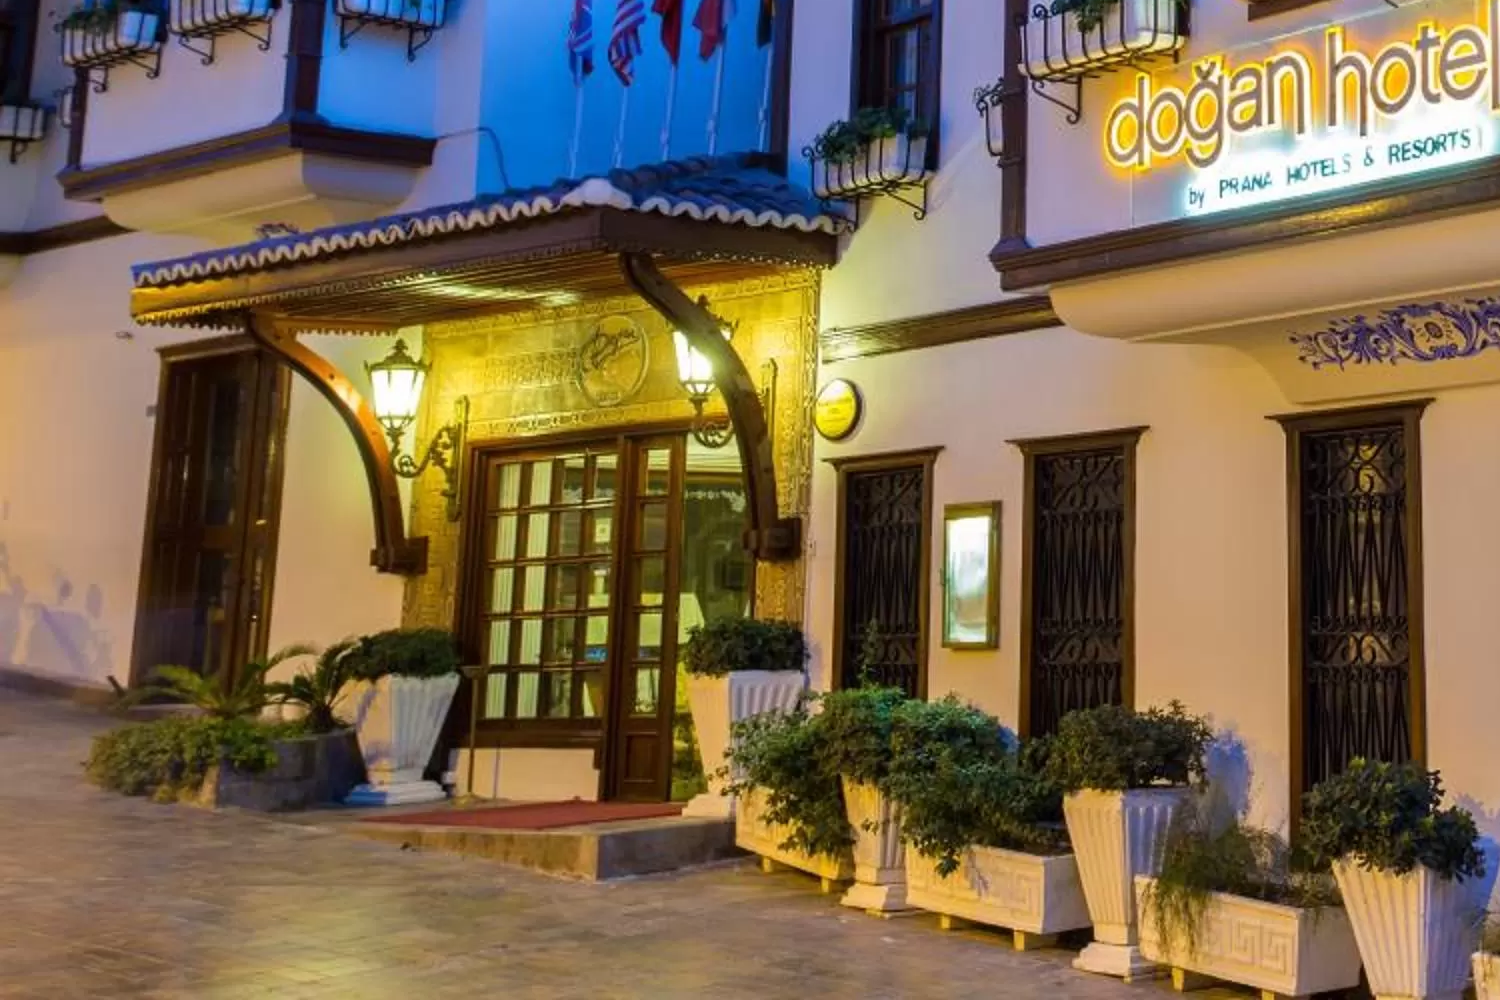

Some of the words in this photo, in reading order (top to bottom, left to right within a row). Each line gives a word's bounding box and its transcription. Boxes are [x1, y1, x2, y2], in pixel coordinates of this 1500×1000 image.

[1106, 55, 1307, 168] doğan
[1189, 186, 1206, 208] by
[1219, 171, 1273, 198] PRANA
[1286, 153, 1351, 184] HOTELS
[1363, 145, 1375, 167] &
[1388, 128, 1472, 165] RESORTS
